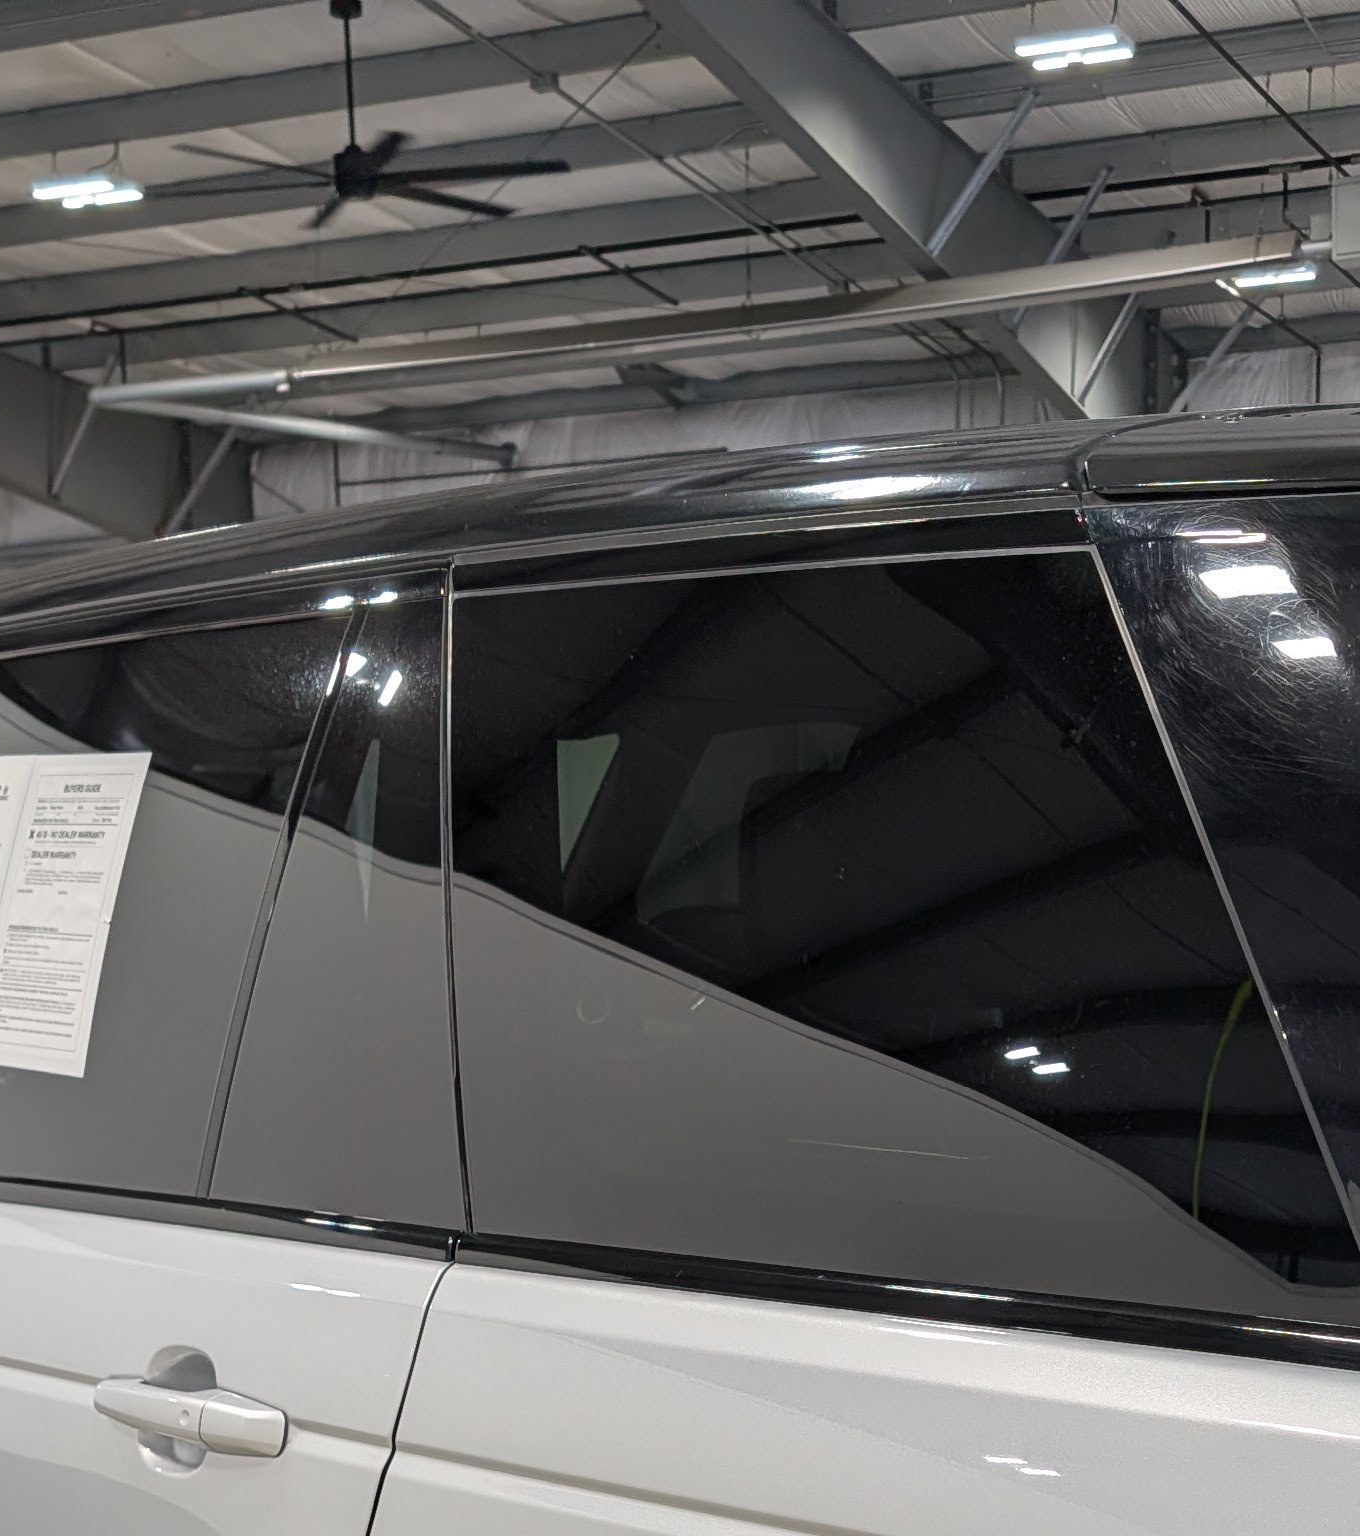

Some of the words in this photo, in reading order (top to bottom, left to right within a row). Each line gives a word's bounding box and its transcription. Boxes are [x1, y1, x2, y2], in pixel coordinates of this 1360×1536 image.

[63, 784, 84, 793] BUYERS
[85, 783, 102, 792] GUIDE
[58, 831, 77, 839] DEALER
[78, 831, 105, 839] WARRANTY
[31, 851, 49, 859] DEALER
[50, 851, 76, 859] WARRANTY
